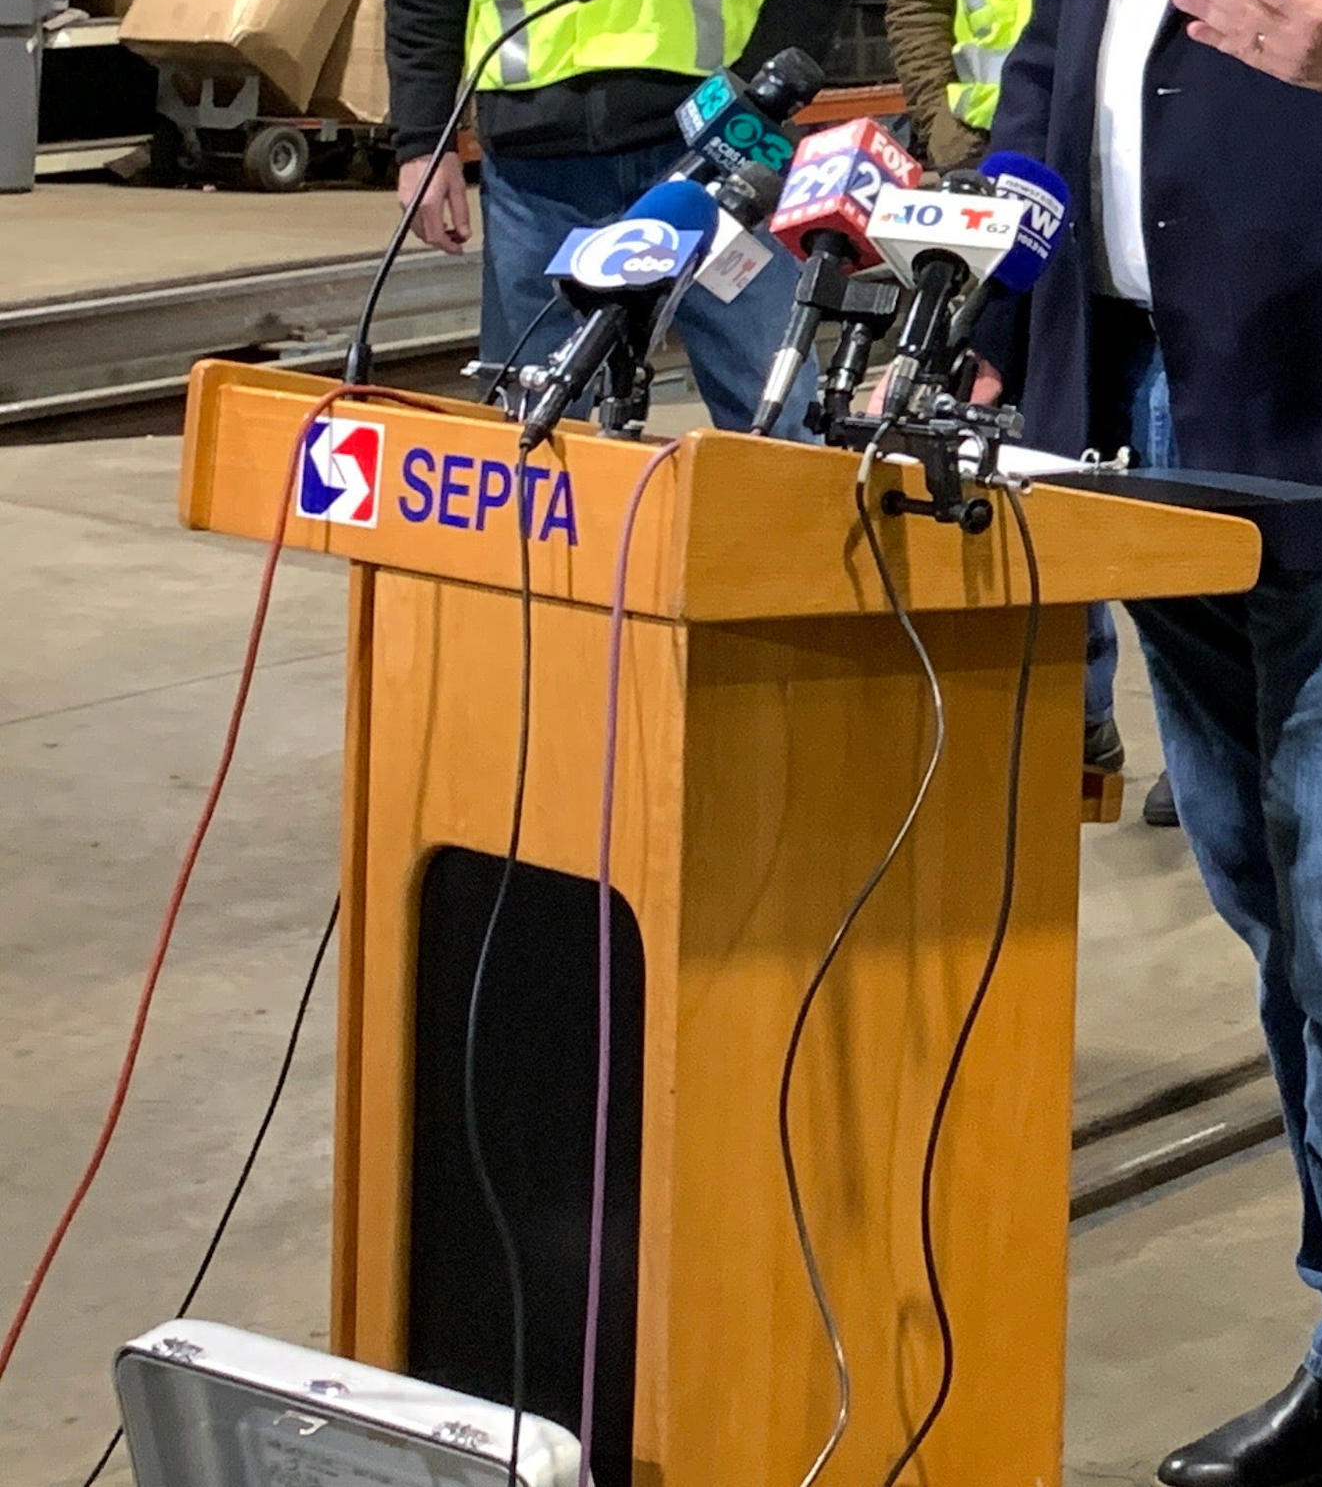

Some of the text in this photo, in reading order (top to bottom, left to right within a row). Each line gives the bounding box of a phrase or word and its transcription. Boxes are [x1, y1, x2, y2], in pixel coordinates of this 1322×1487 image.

[781, 155, 851, 210] 29
[870, 131, 915, 187] FOX
[849, 161, 897, 213] 2
[903, 204, 943, 226] 10
[986, 224, 1011, 234] 62
[623, 257, 676, 273] abc
[398, 447, 578, 547] SEPTA
